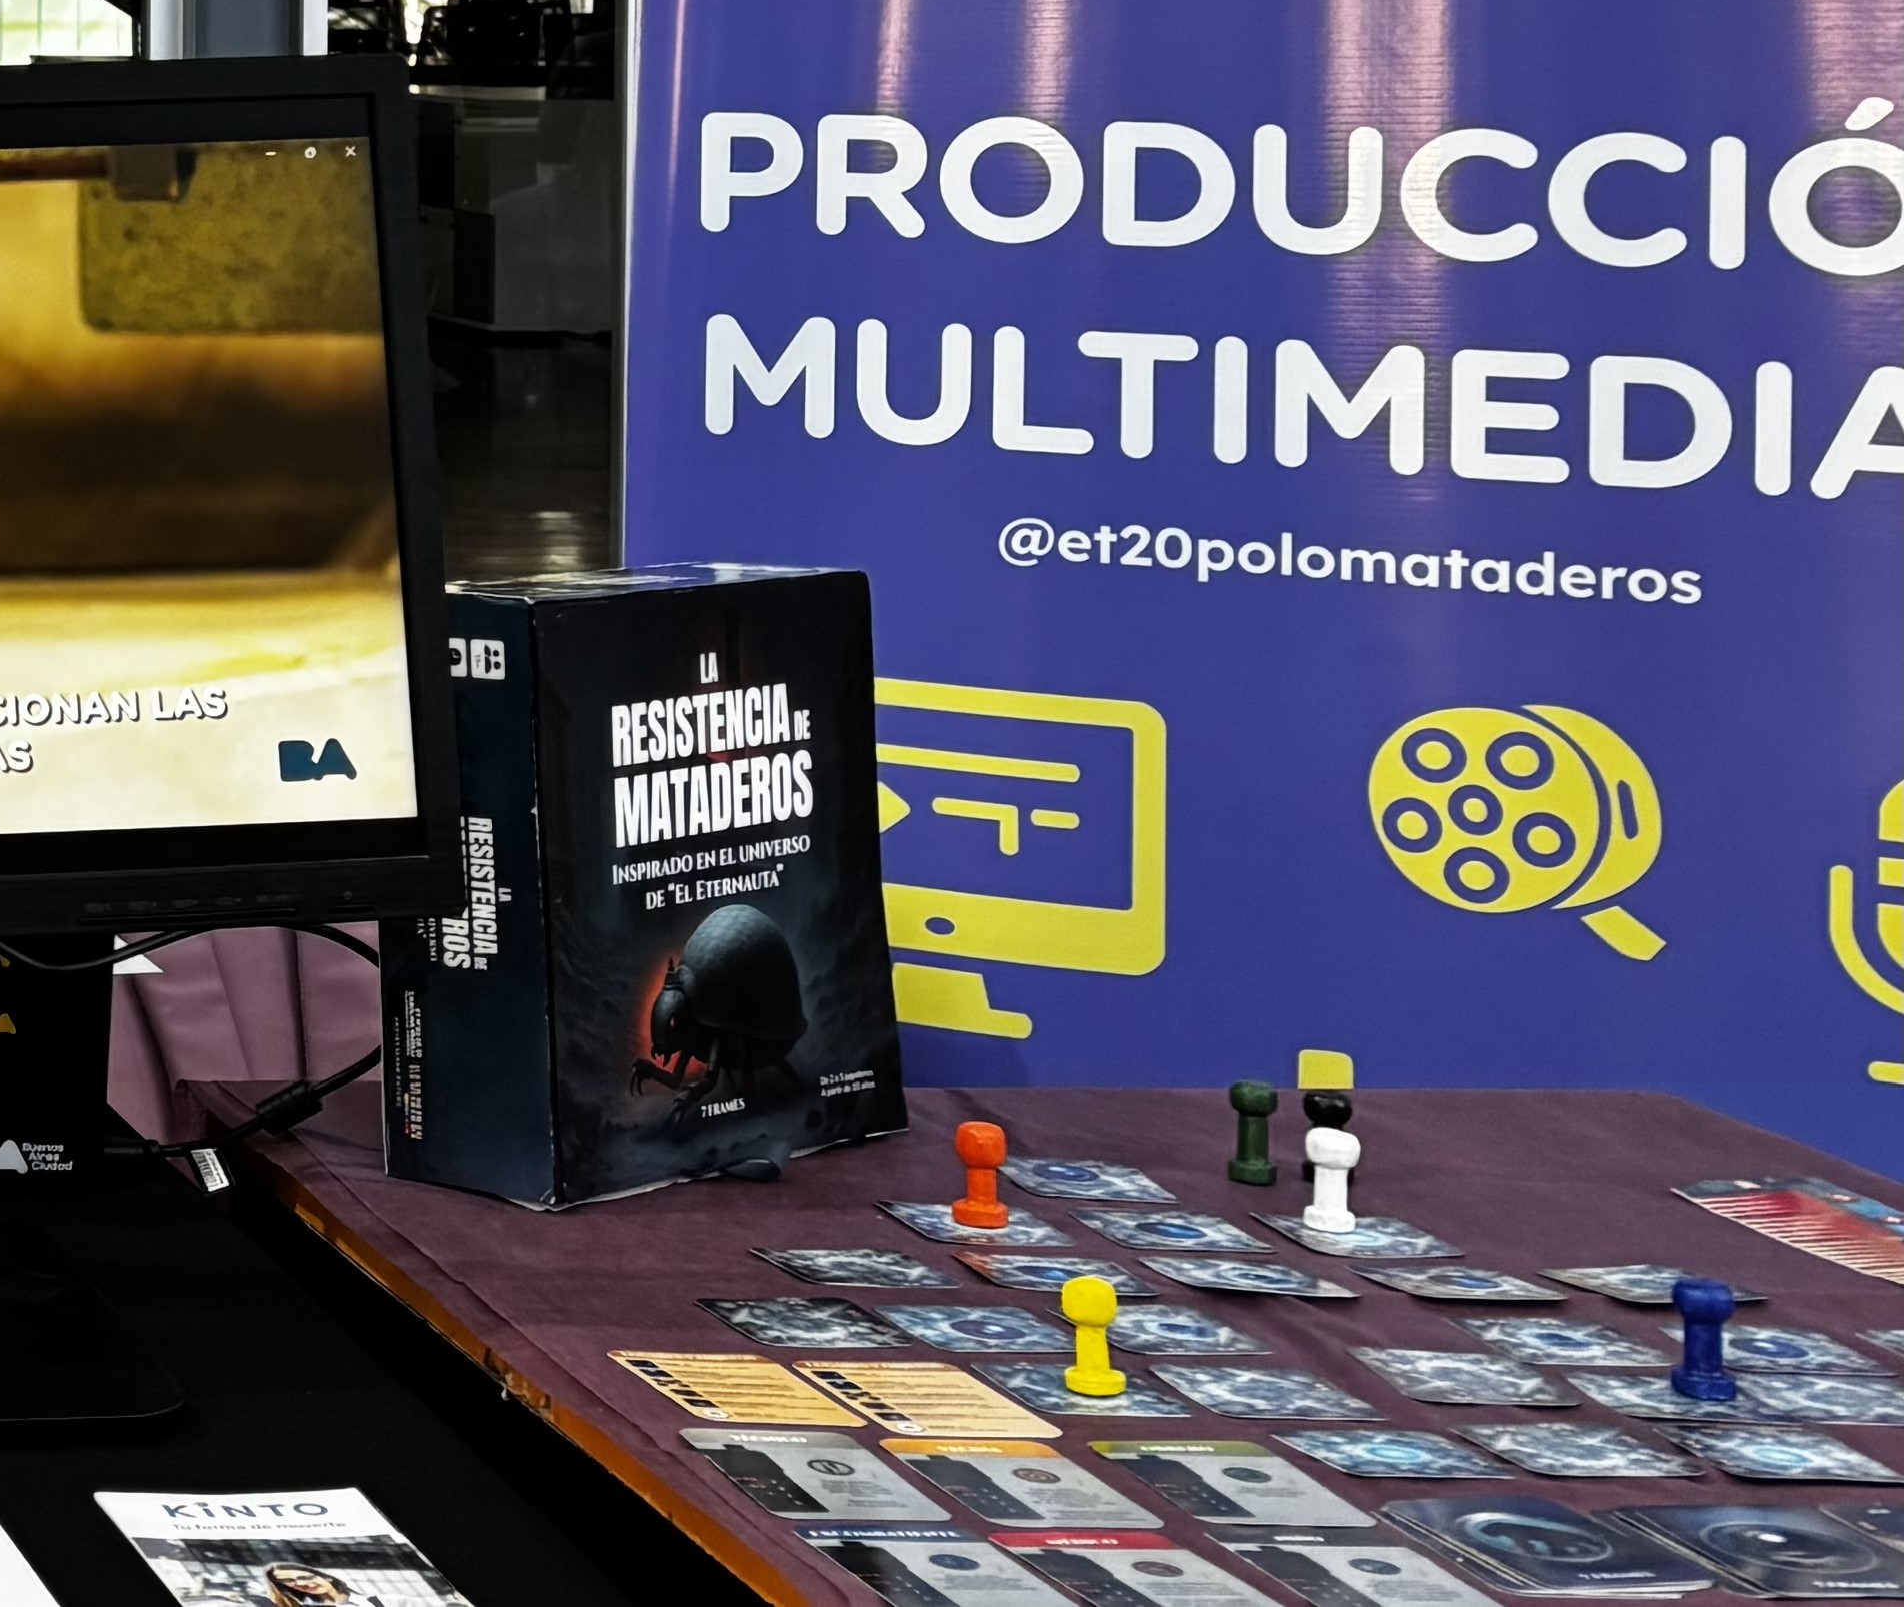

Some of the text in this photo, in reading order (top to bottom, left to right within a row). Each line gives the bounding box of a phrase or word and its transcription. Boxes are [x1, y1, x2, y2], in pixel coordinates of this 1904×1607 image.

[700, 96, 1904, 277] PRODUCCIÓ
[997, 516, 1704, 604] @et20polomataderos
[700, 652, 719, 684] LA
[151, 687, 229, 722] LAS
[611, 683, 811, 768] RESISTENCIA DE
[614, 749, 814, 849] MATADEROS
[696, 850, 716, 871] EN
[719, 847, 736, 866] EL
[739, 834, 811, 864] UNIVERSO
[467, 817, 499, 955] RESISTENCIA
[498, 887, 512, 902] LA
[645, 890, 666, 910] DE
[707, 1097, 746, 1117] FRAMES
